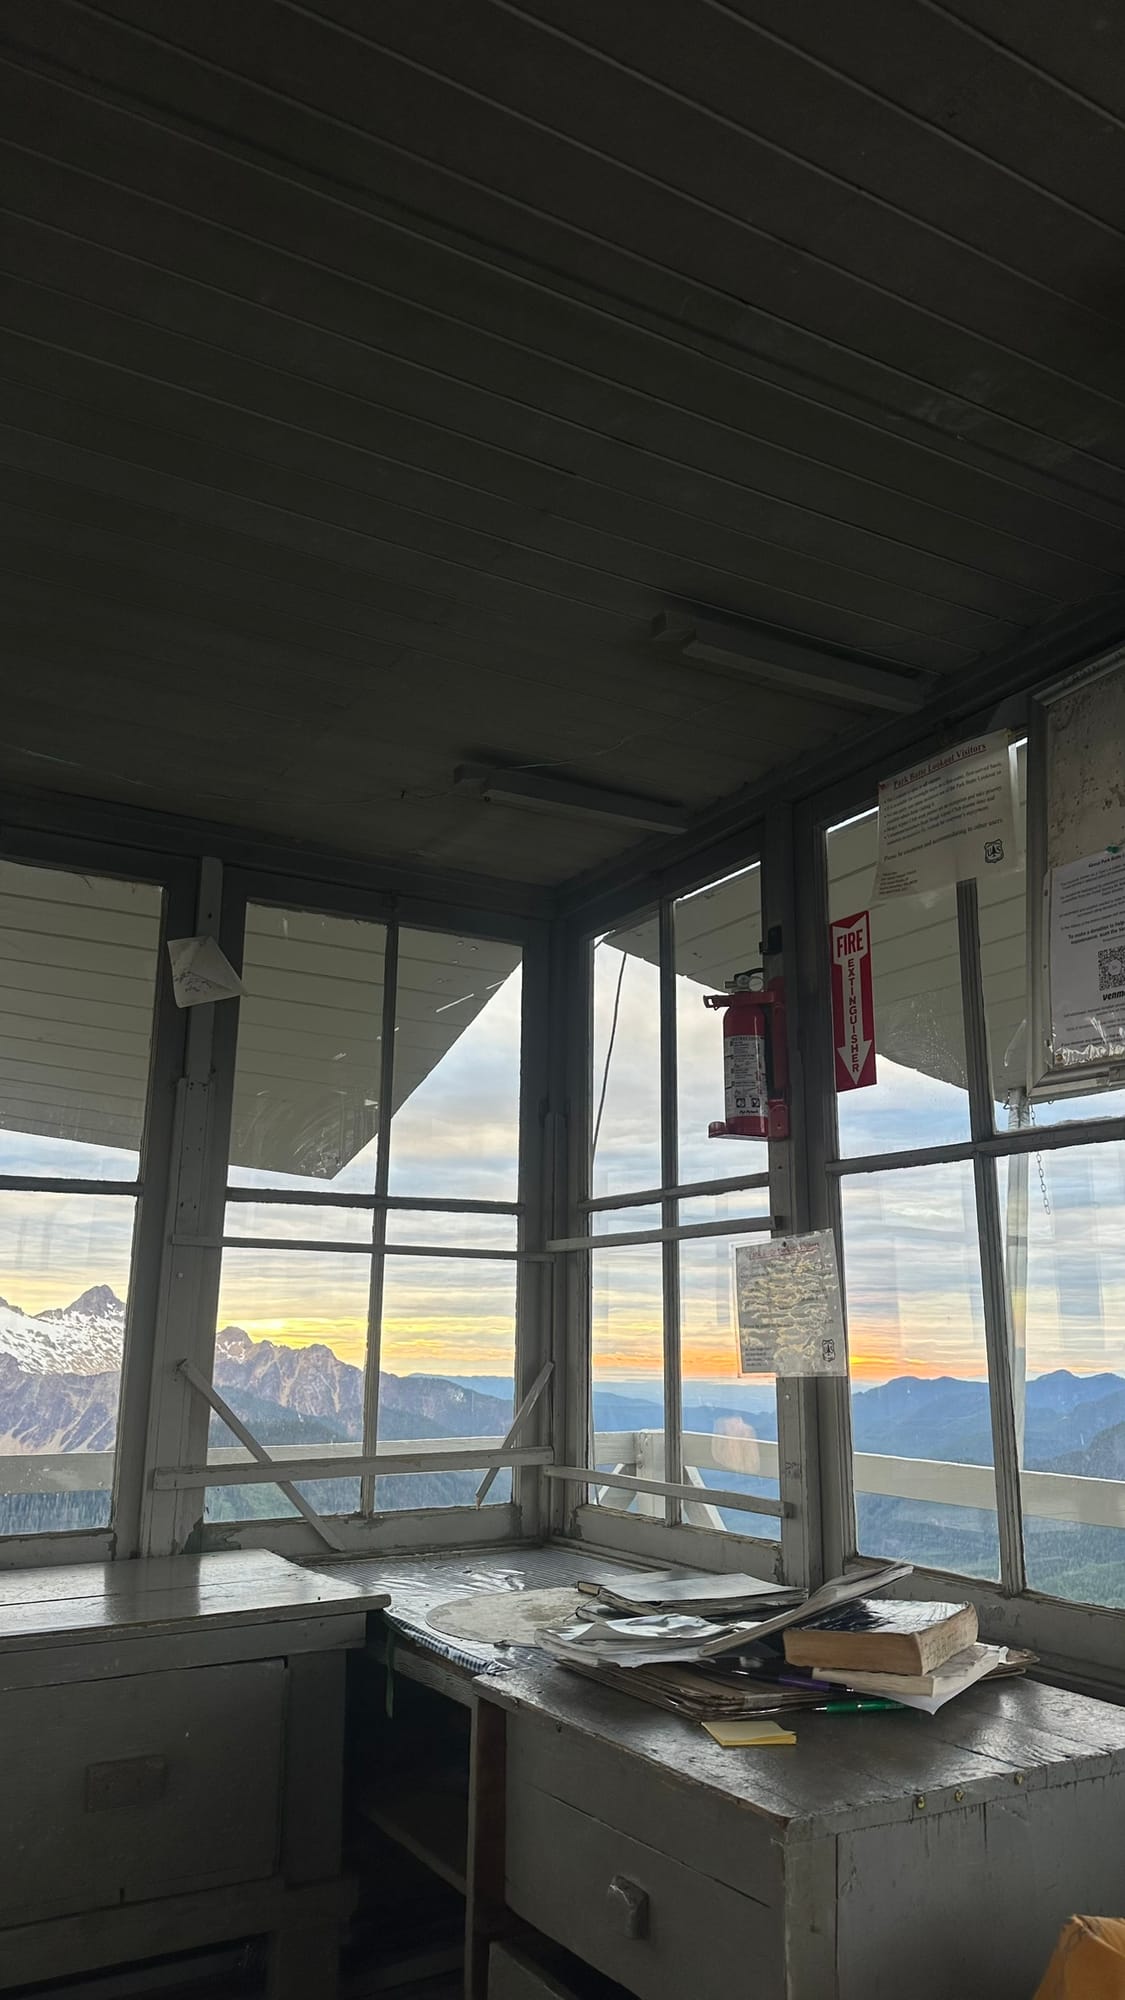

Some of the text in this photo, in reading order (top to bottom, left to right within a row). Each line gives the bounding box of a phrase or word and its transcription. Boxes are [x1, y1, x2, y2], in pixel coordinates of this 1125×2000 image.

[894, 776, 910, 789] Park
[928, 753, 955, 773] Lookout
[956, 743, 987, 759] Visitors
[837, 929, 863, 957] FIRE
[848, 958, 860, 1072] EXTINGUISHER
